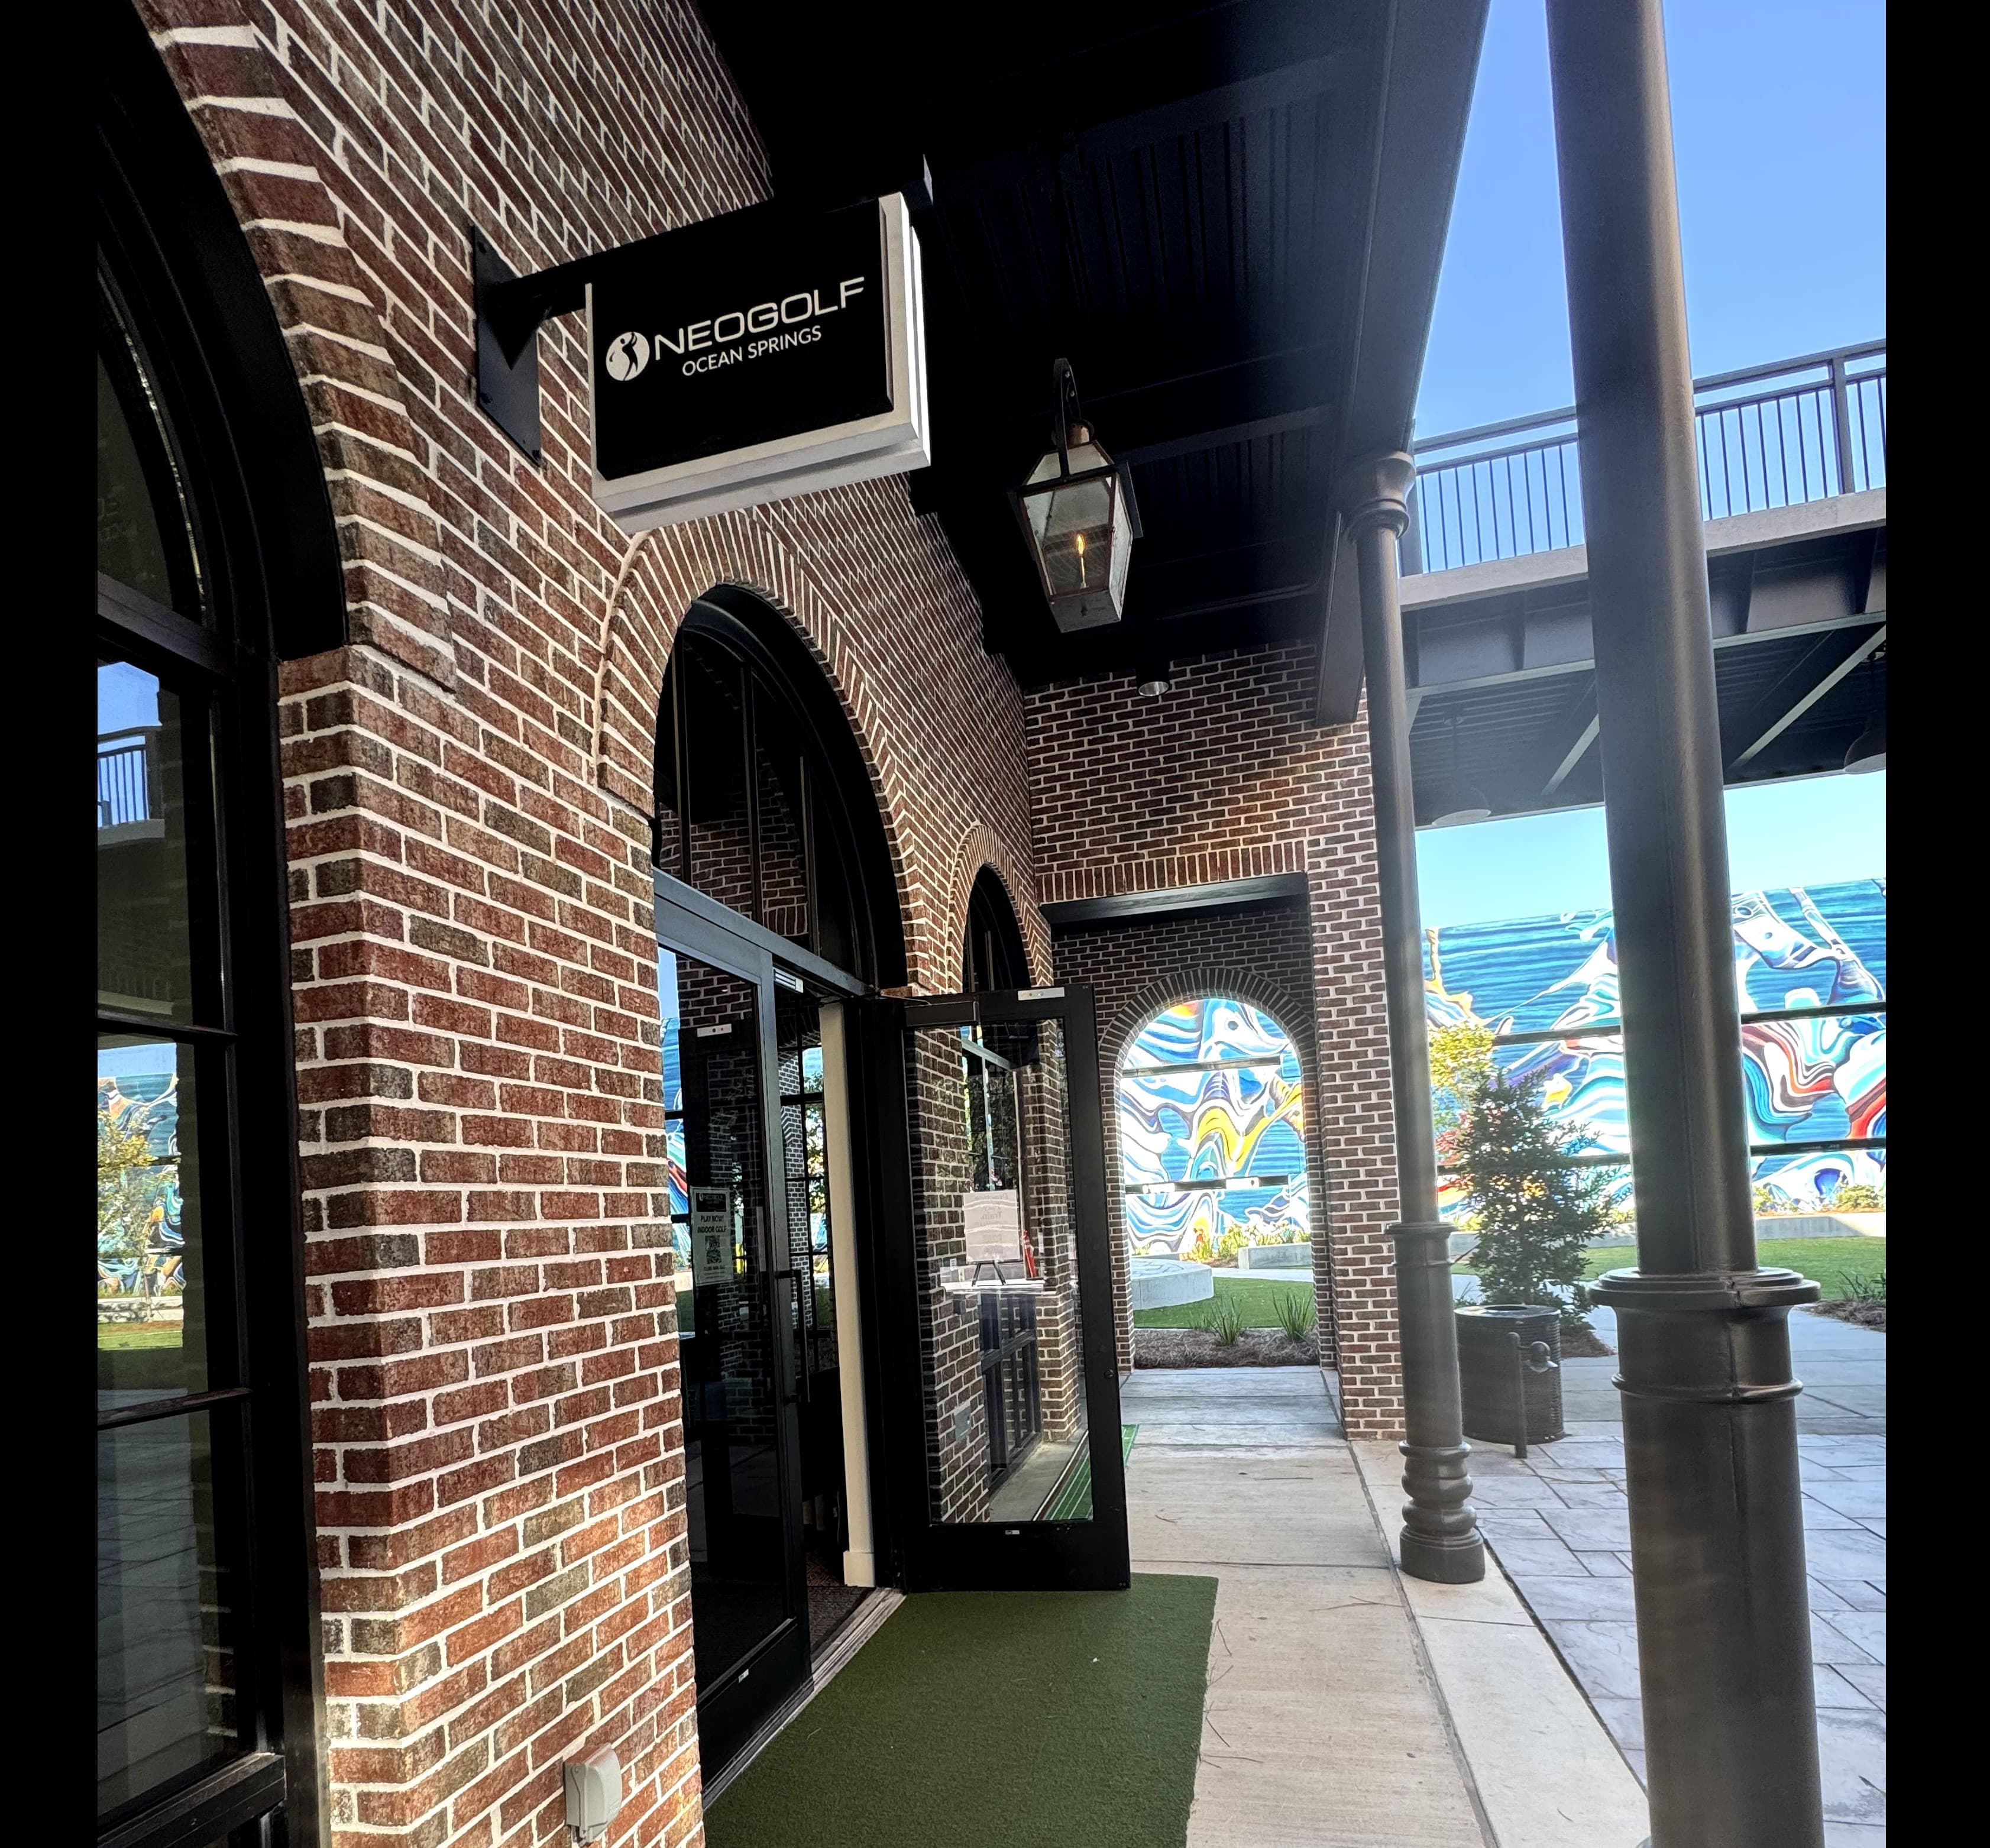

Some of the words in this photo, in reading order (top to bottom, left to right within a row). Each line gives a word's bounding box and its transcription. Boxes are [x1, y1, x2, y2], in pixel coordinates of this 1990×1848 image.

[655, 276, 865, 361] NEOGOLF
[682, 347, 743, 376] OCEAN
[748, 325, 822, 359] SPRINGS
[697, 1225, 714, 1234] INDOOR
